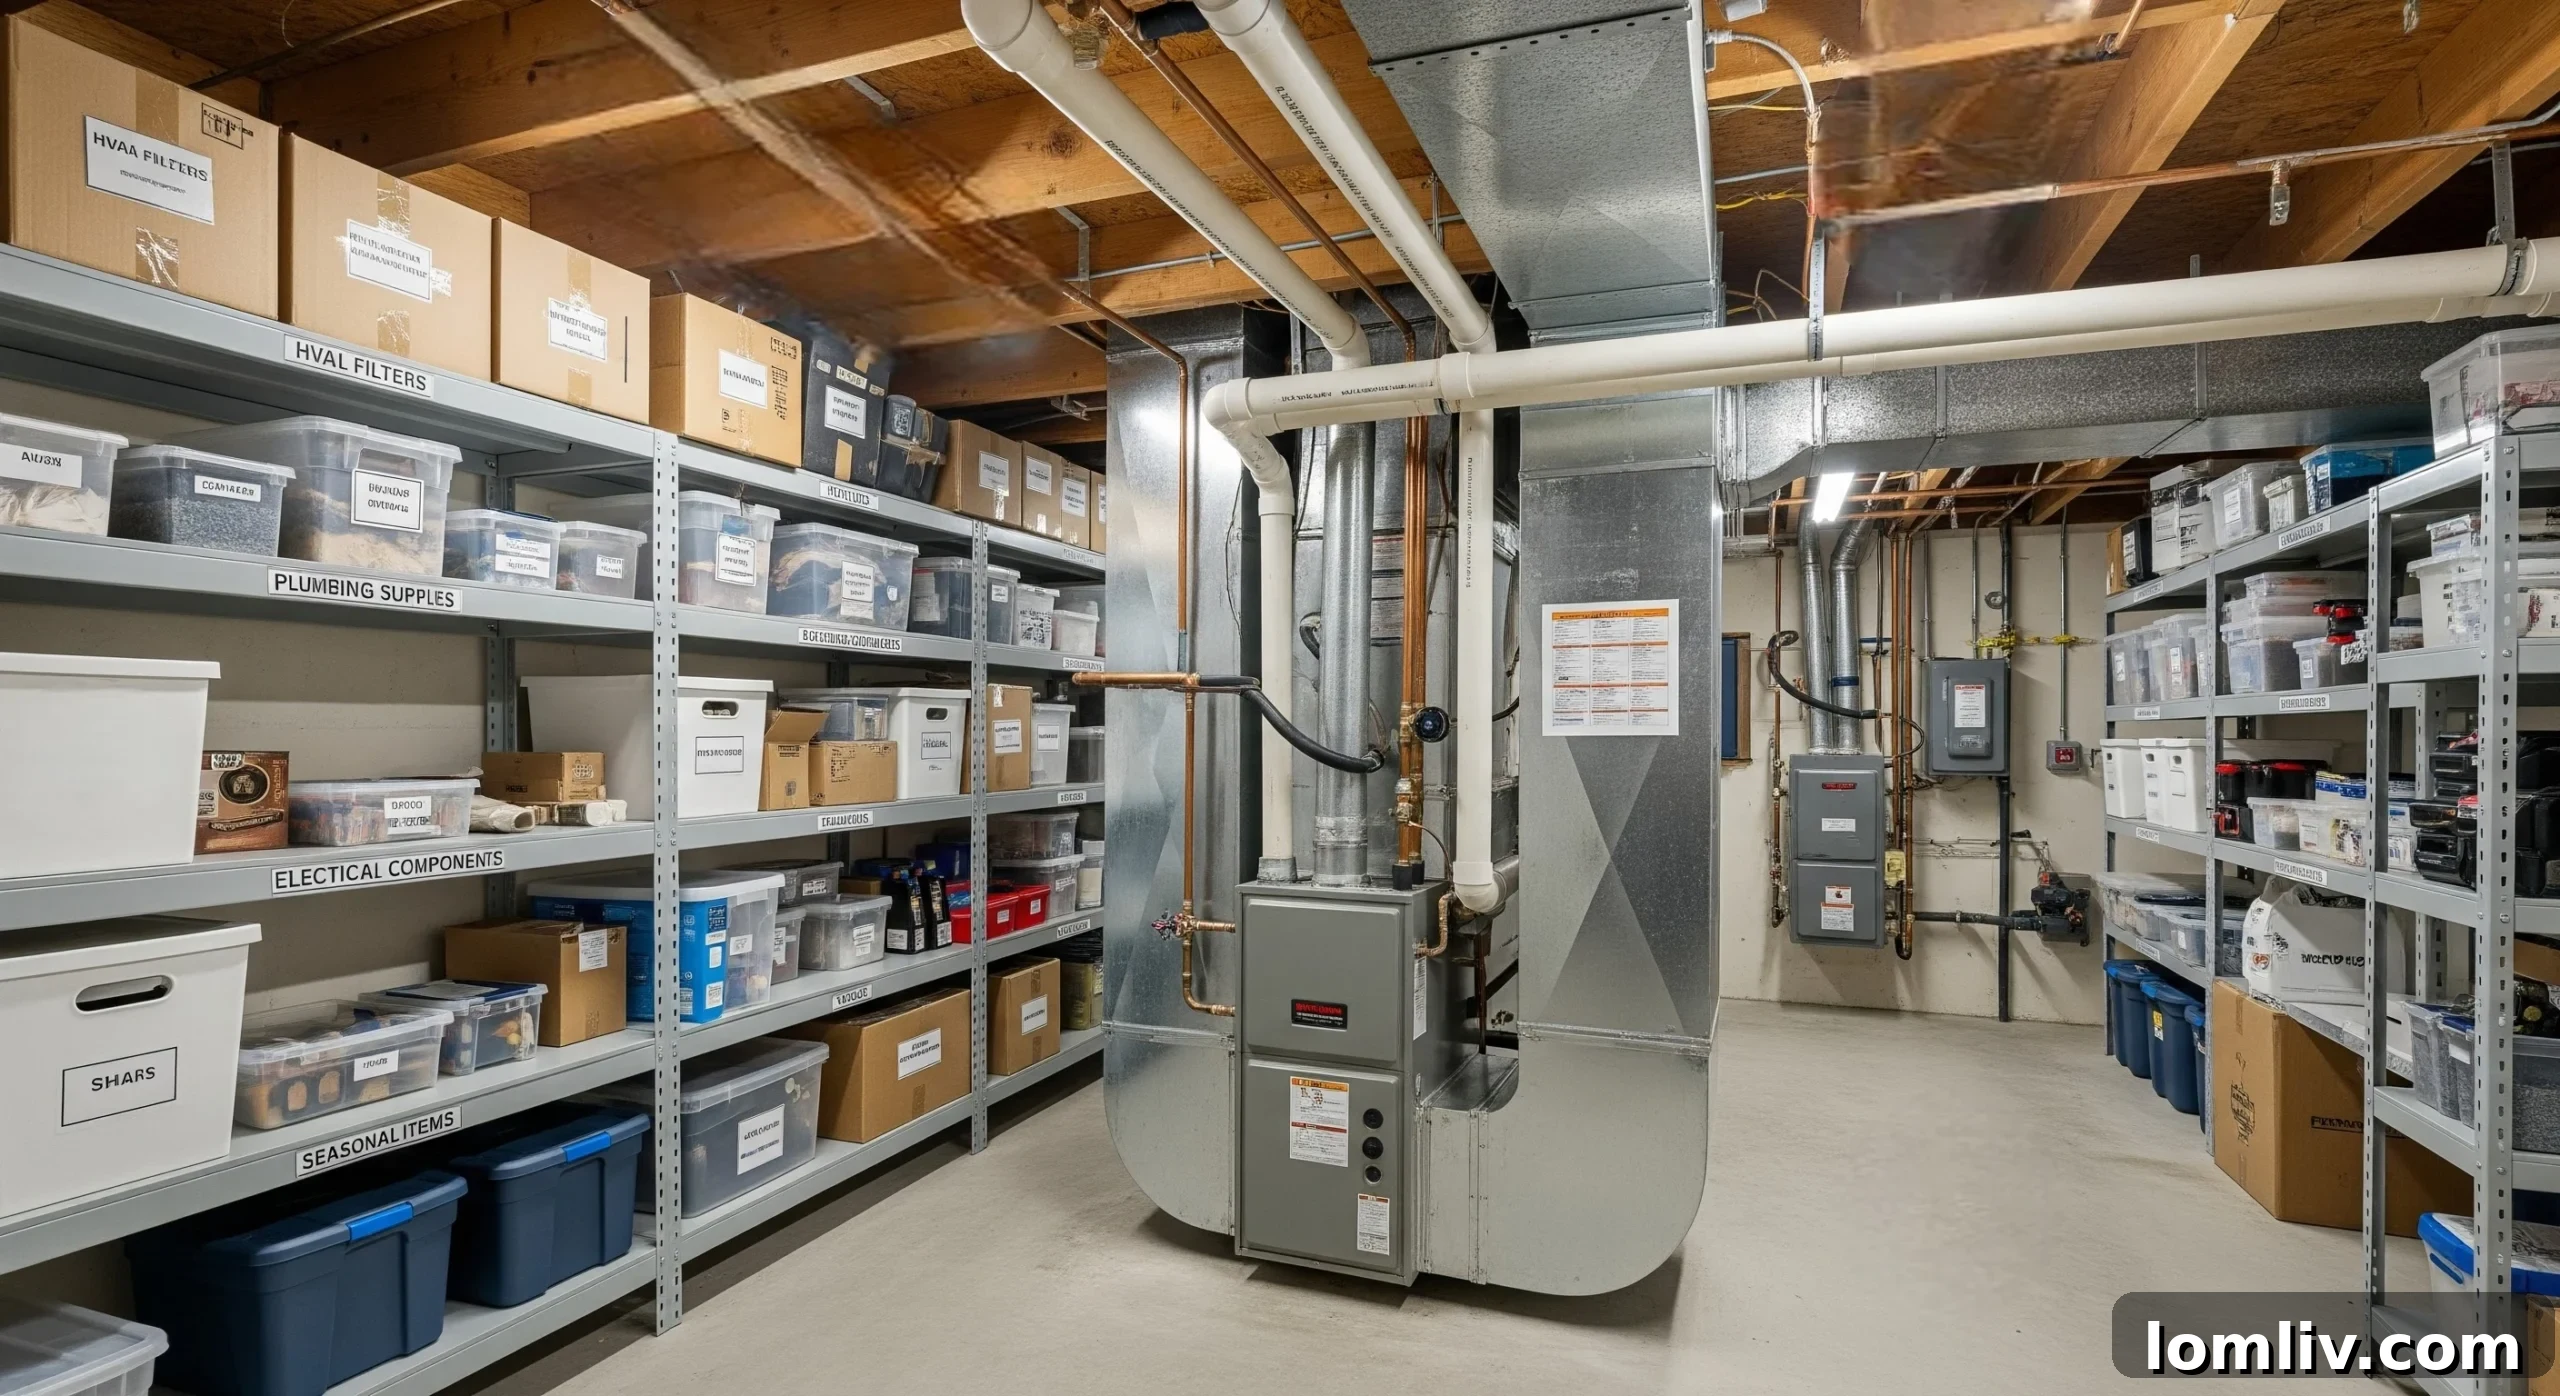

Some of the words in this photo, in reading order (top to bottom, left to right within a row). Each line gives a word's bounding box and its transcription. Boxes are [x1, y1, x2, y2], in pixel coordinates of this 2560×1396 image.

[296, 341, 348, 371] HVAL
[354, 357, 427, 391] FILTERS
[274, 573, 374, 599] PLUMBING
[275, 862, 383, 889] ELECTICAL
[388, 850, 503, 877] COMPONENTS
[91, 1066, 156, 1092] SHARS
[302, 1127, 400, 1170] SEASONAL
[403, 1111, 455, 1140] ITEMS
